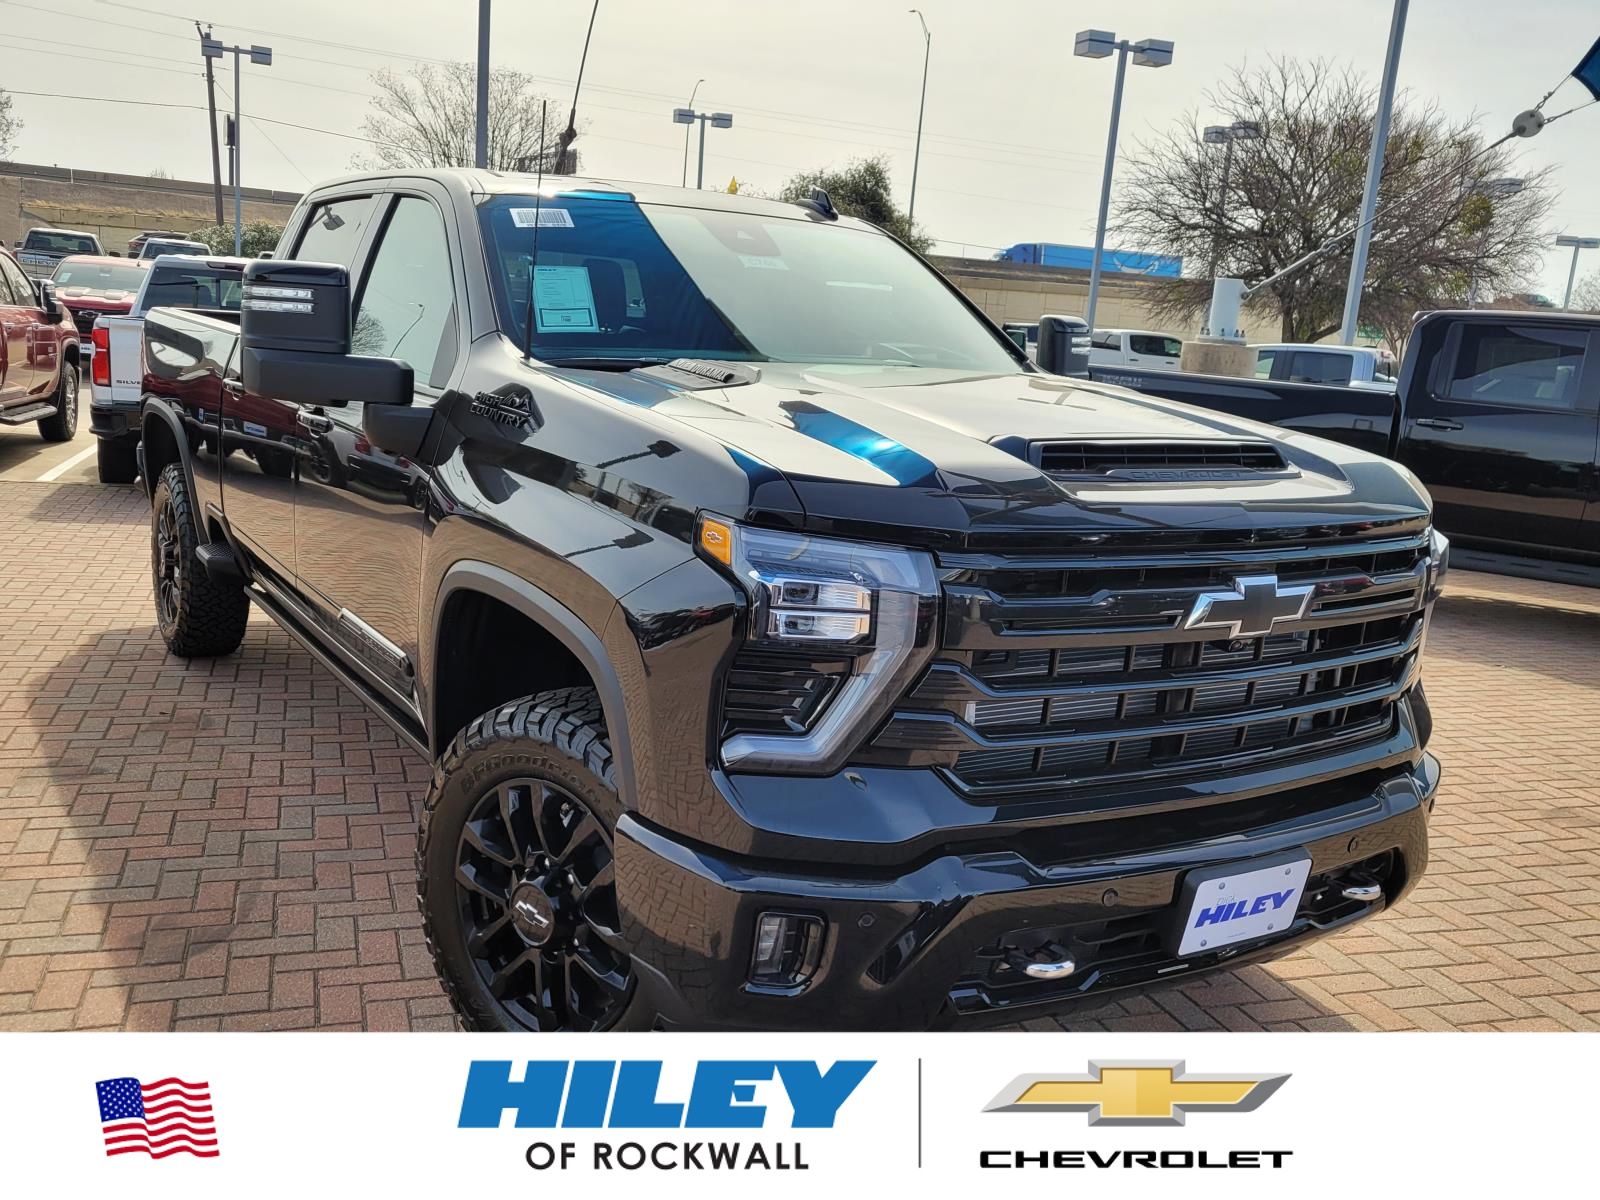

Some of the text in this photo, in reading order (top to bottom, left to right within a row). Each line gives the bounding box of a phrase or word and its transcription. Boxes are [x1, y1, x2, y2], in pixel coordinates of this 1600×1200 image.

[474, 391, 505, 407] HIGH
[470, 405, 526, 429] COUNTRY
[1129, 470, 1241, 480] CHEVROLET
[1194, 888, 1296, 928] HILEY
